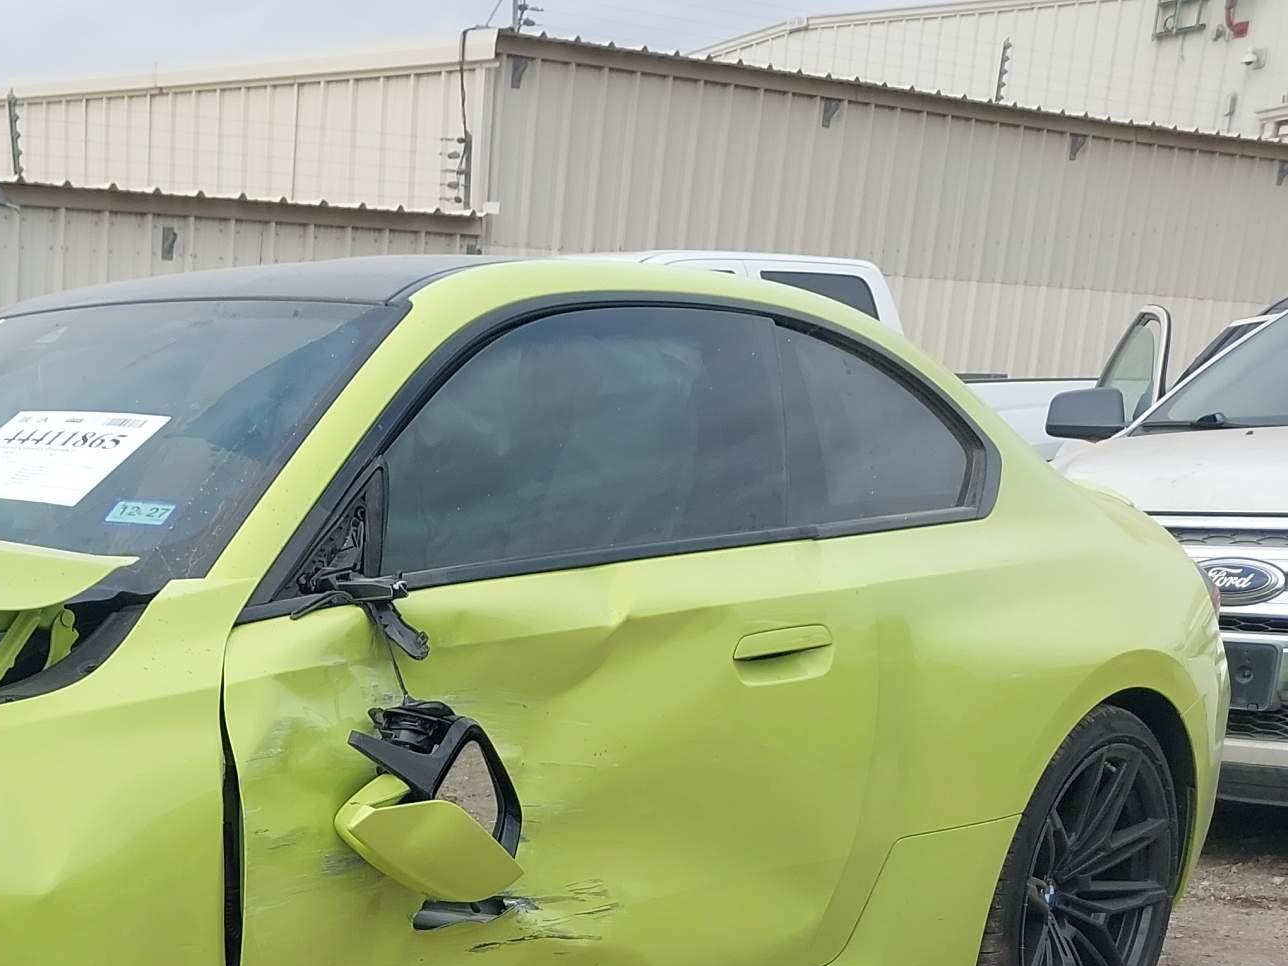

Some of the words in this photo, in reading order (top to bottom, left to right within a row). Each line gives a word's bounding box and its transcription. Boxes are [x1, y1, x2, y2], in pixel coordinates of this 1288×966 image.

[3, 429, 129, 450] 44411865
[145, 506, 171, 518] 27
[1208, 567, 1255, 588] Ford
